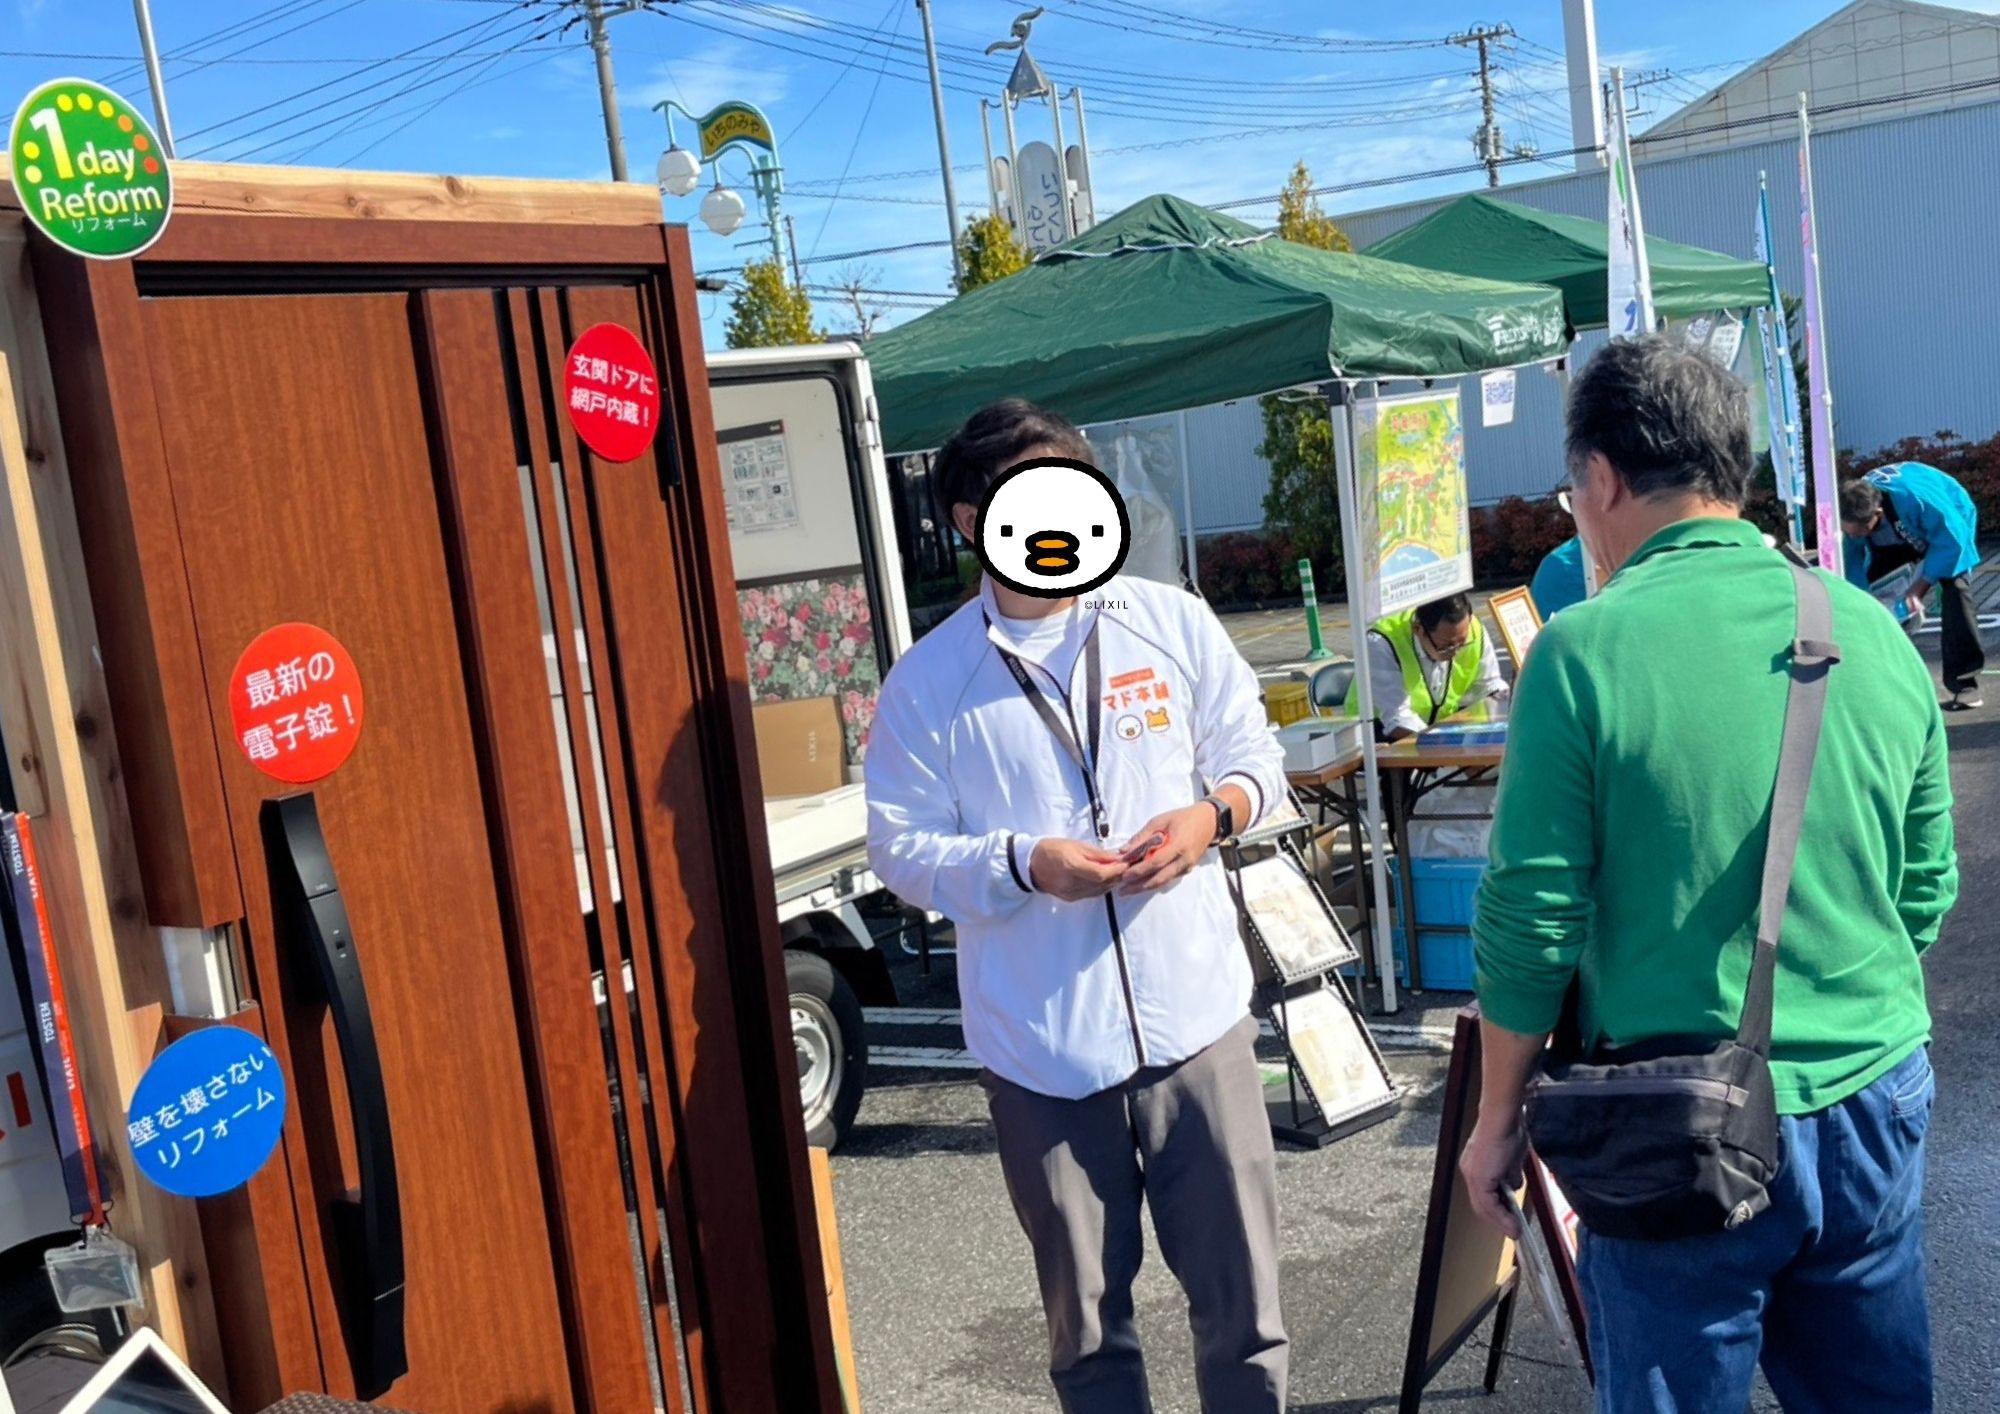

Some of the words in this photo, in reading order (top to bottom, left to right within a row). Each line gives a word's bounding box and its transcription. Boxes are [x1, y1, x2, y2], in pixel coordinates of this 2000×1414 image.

[705, 114, 760, 147] いちのみや
[39, 181, 163, 221] Reform
[71, 213, 147, 234] リフォーム
[573, 354, 654, 396] 玄関ドアに
[570, 386, 649, 428] 網戸内蔵！
[245, 652, 335, 709] 最新の
[243, 694, 355, 760] 電子錠！
[39, 1001, 56, 1044] TOSTEM
[127, 1046, 271, 1149] 壁を壊さない
[157, 1087, 275, 1169] リフォーム
